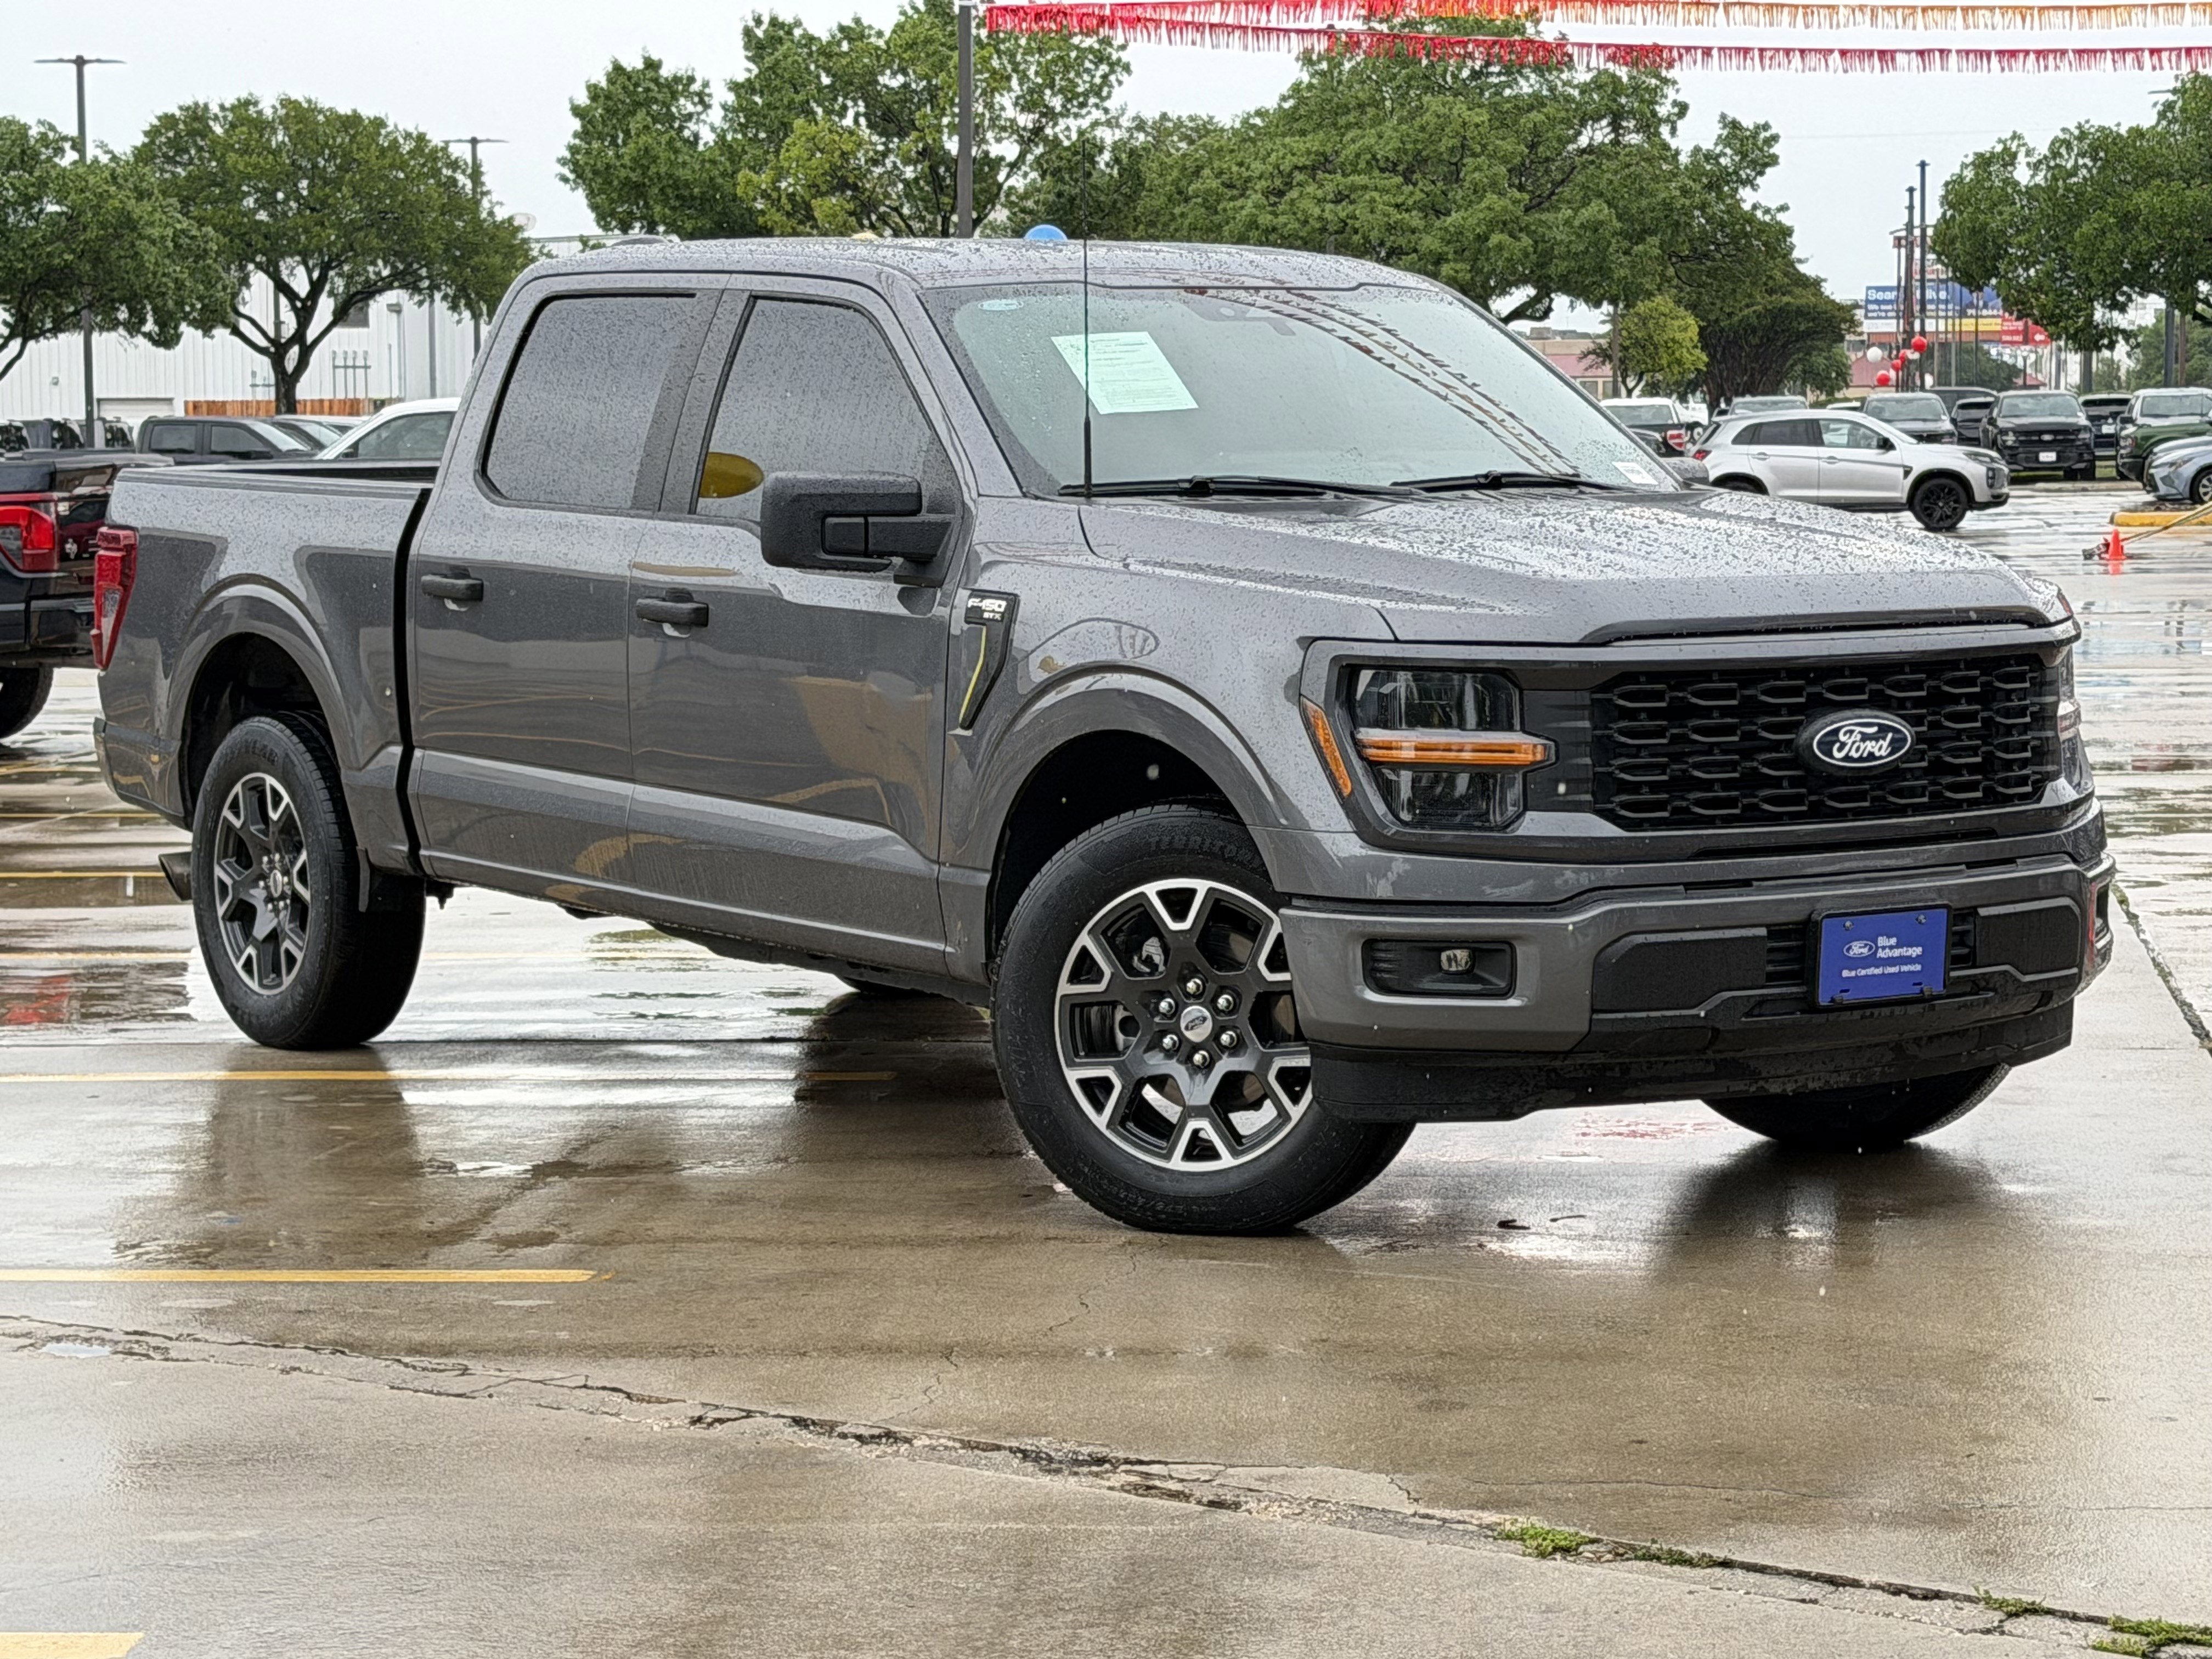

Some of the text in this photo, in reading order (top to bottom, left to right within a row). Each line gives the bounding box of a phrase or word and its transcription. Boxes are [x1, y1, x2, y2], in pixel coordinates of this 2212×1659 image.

[967, 598, 1007, 612] F-150
[1833, 726, 1893, 758] Ford
[1877, 936, 1897, 946] Blue
[1849, 944, 1870, 955] Ford
[1877, 946, 1922, 958] Advantage
[1857, 967, 1883, 976] Certified
[1884, 966, 1899, 974] Used
